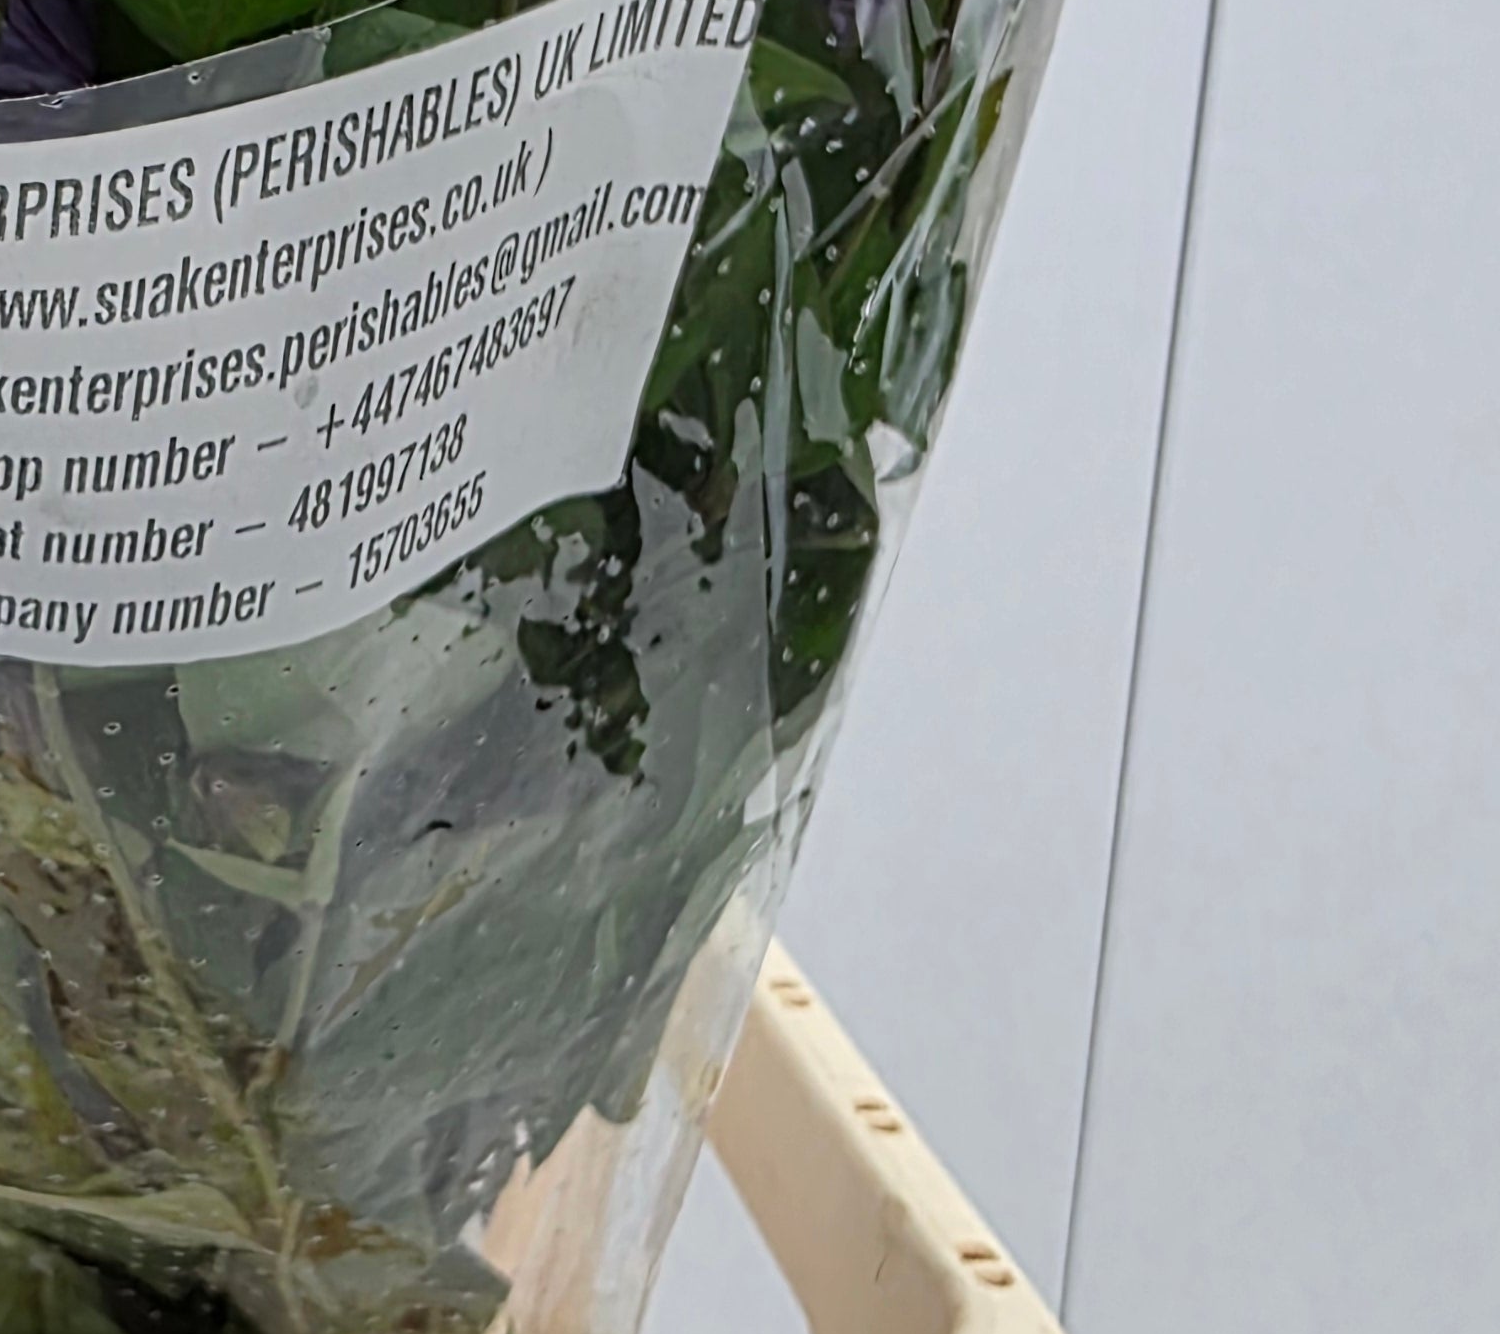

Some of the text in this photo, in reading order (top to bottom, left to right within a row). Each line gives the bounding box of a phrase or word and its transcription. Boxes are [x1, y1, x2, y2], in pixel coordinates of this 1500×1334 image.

[214, 53, 522, 224] (PERISHABLES)
[535, 23, 584, 100] UK
[62, 433, 236, 494] number
[316, 274, 576, 449] +447467483697
[42, 517, 214, 565] number
[287, 412, 467, 533] 481997138
[112, 579, 276, 634] number
[348, 469, 487, 590] 15703655
